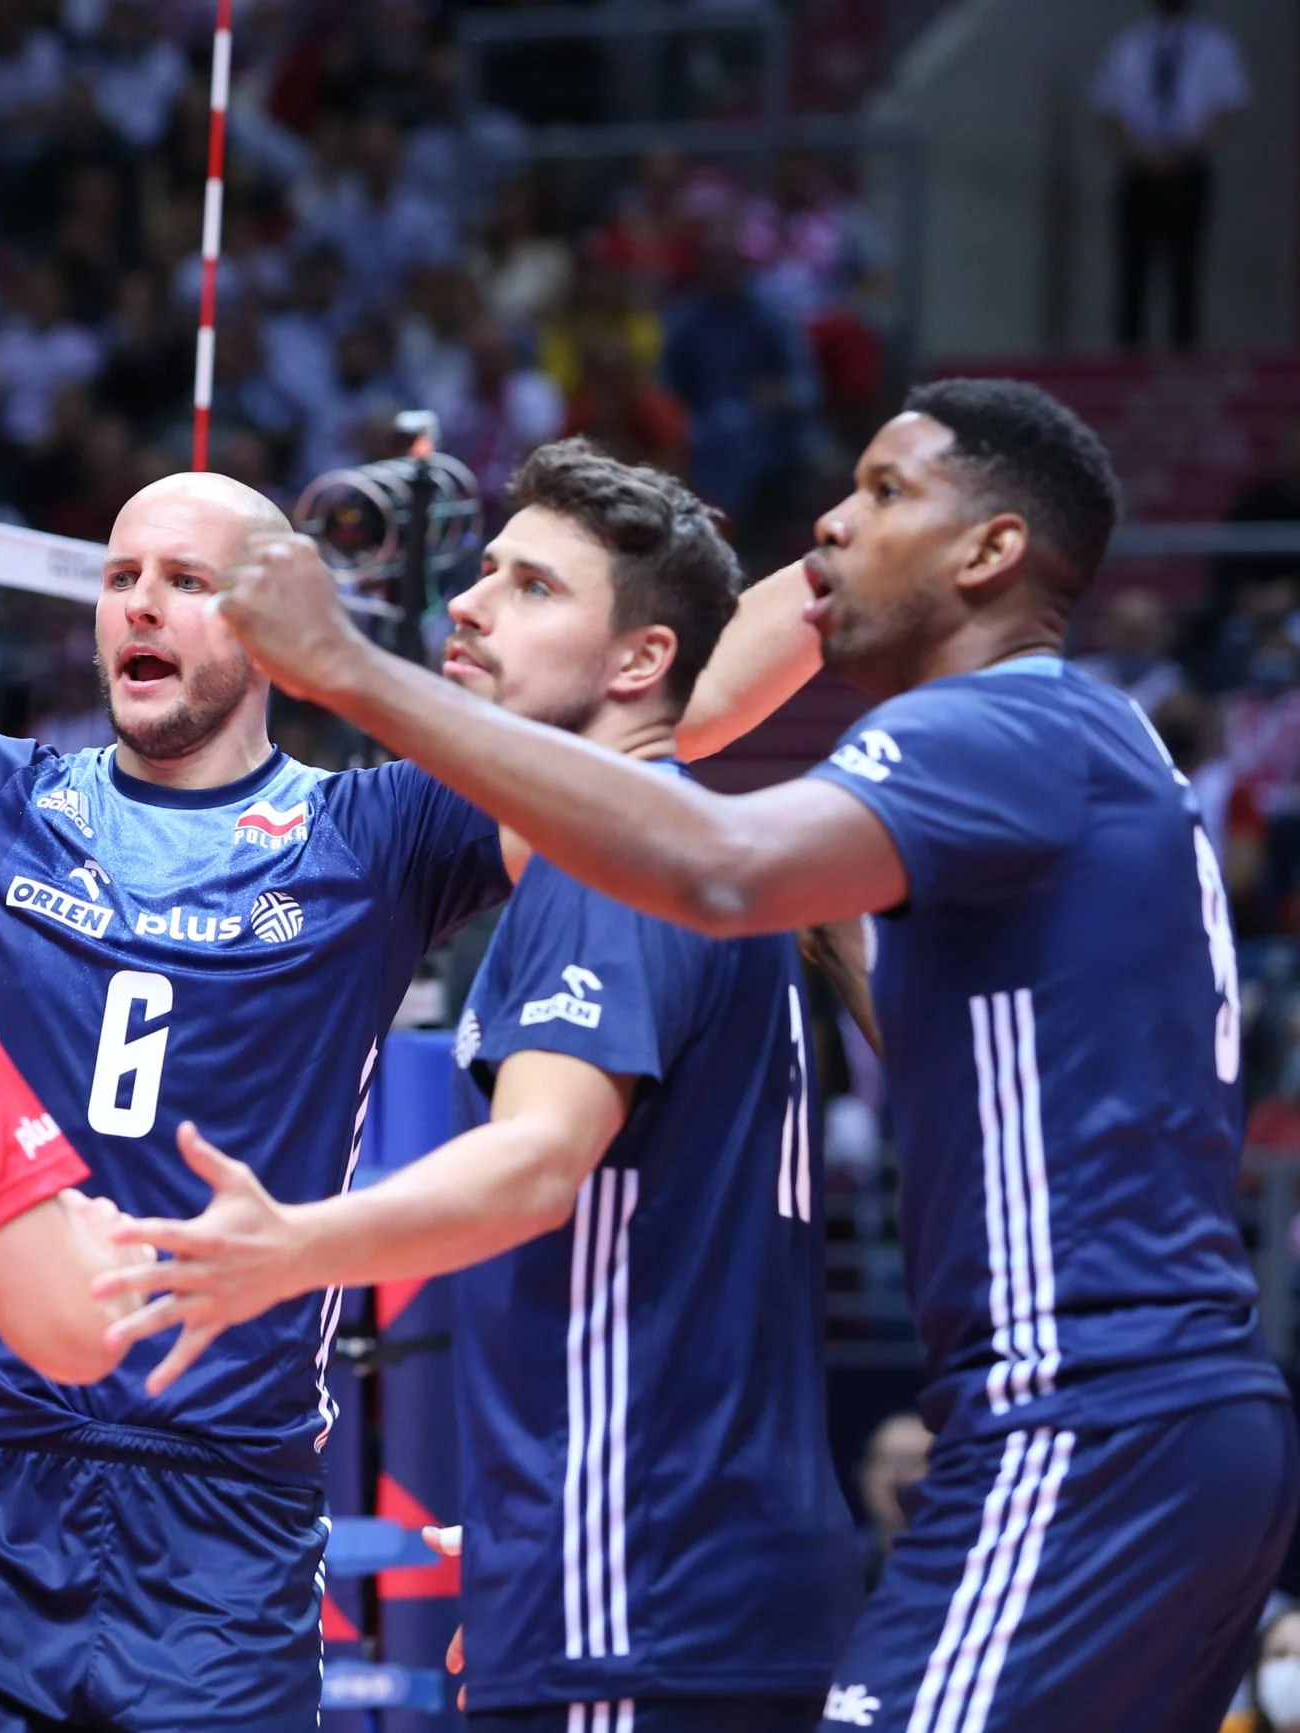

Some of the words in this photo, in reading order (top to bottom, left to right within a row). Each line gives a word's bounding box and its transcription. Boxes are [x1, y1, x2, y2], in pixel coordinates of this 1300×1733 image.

[36, 797, 95, 838] adidas
[13, 883, 105, 933] ORLEN
[134, 906, 241, 942] plus
[87, 970, 173, 1138] 6
